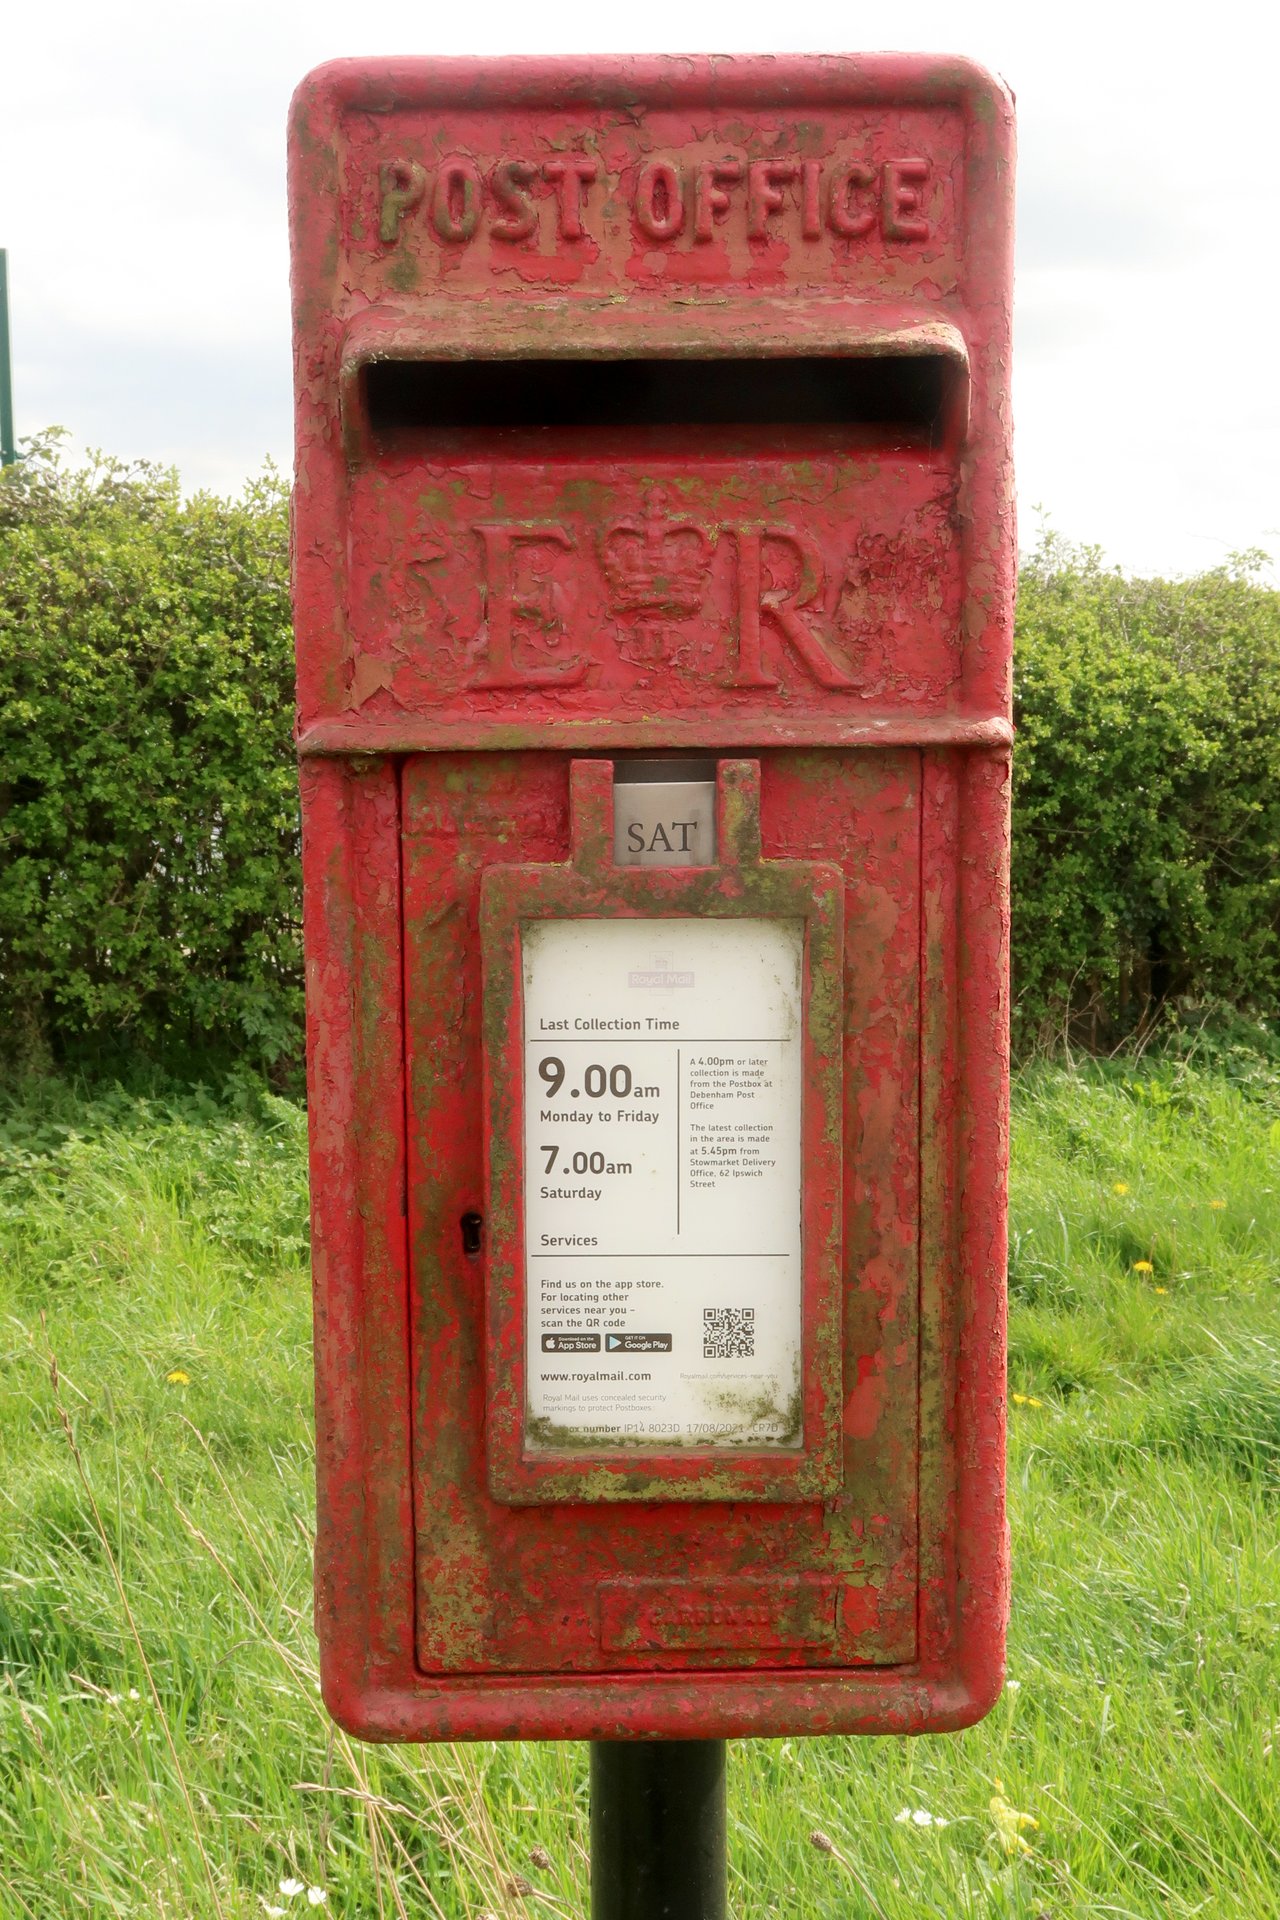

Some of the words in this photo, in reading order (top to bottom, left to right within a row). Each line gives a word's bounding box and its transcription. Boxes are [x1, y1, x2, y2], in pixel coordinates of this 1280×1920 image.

[378, 158, 596, 244] POST
[634, 158, 931, 244] OFFICE
[471, 522, 590, 692] E
[718, 524, 867, 693] R
[627, 821, 698, 853] SAT
[631, 974, 664, 986] Royal
[666, 974, 691, 985] Mail
[540, 1018, 569, 1031] Last
[574, 1018, 641, 1031] Collection
[645, 1018, 680, 1031] Time
[690, 1058, 696, 1066] A
[698, 1056, 734, 1067] 4.00pm
[748, 1058, 769, 1066] later
[538, 1056, 661, 1099] 9.00am
[690, 1069, 729, 1077] collection
[732, 1069, 739, 1077] is
[742, 1069, 765, 1077] made
[690, 1080, 710, 1088] from
[713, 1080, 726, 1088] the
[729, 1080, 762, 1088] Postbox
[764, 1080, 773, 1088] at
[690, 1091, 734, 1099] Debenham
[737, 1091, 755, 1099] Post
[690, 1102, 714, 1110] Office
[540, 1110, 593, 1125] Monday
[598, 1111, 612, 1122] to
[617, 1110, 659, 1125] Friday
[690, 1124, 706, 1132] The
[709, 1124, 732, 1132] latest
[734, 1124, 774, 1132] collection
[690, 1135, 698, 1143] in
[700, 1135, 714, 1143] the
[738, 1135, 745, 1143] is
[747, 1135, 770, 1143] made
[701, 1146, 737, 1156] 5.45pm
[740, 1147, 760, 1155] from
[540, 1145, 632, 1175] 7.00am
[690, 1158, 740, 1167] Stowmarket
[742, 1158, 776, 1168] Delivery
[690, 1169, 717, 1178] Office,
[719, 1169, 730, 1177] 62
[732, 1169, 763, 1178] Ipswich
[690, 1180, 716, 1188] Street
[540, 1186, 602, 1201] Saturday
[540, 1234, 598, 1246] Services
[541, 1280, 562, 1288] Find
[595, 1280, 612, 1288] the
[615, 1281, 633, 1290] app
[636, 1280, 664, 1288] store.
[541, 1293, 557, 1301] For
[560, 1292, 599, 1303] locating
[602, 1293, 629, 1301] other
[541, 1305, 581, 1314] services
[609, 1307, 627, 1316] you
[566, 1318, 583, 1327] the
[586, 1319, 600, 1327] QR
[603, 1319, 626, 1327] code
[558, 1342, 574, 1350] App
[575, 1341, 597, 1349] Store
[625, 1341, 652, 1350] Google
[653, 1341, 668, 1350] Play
[541, 1371, 651, 1383] www.royalmail.com
[543, 1394, 562, 1402] Royal
[638, 1394, 667, 1402] security
[543, 1404, 576, 1413] markings
[584, 1425, 621, 1433] number
[624, 1424, 645, 1433] IP14
[648, 1424, 680, 1433] 8023D
[686, 1423, 744, 1434] 17/08/2021
